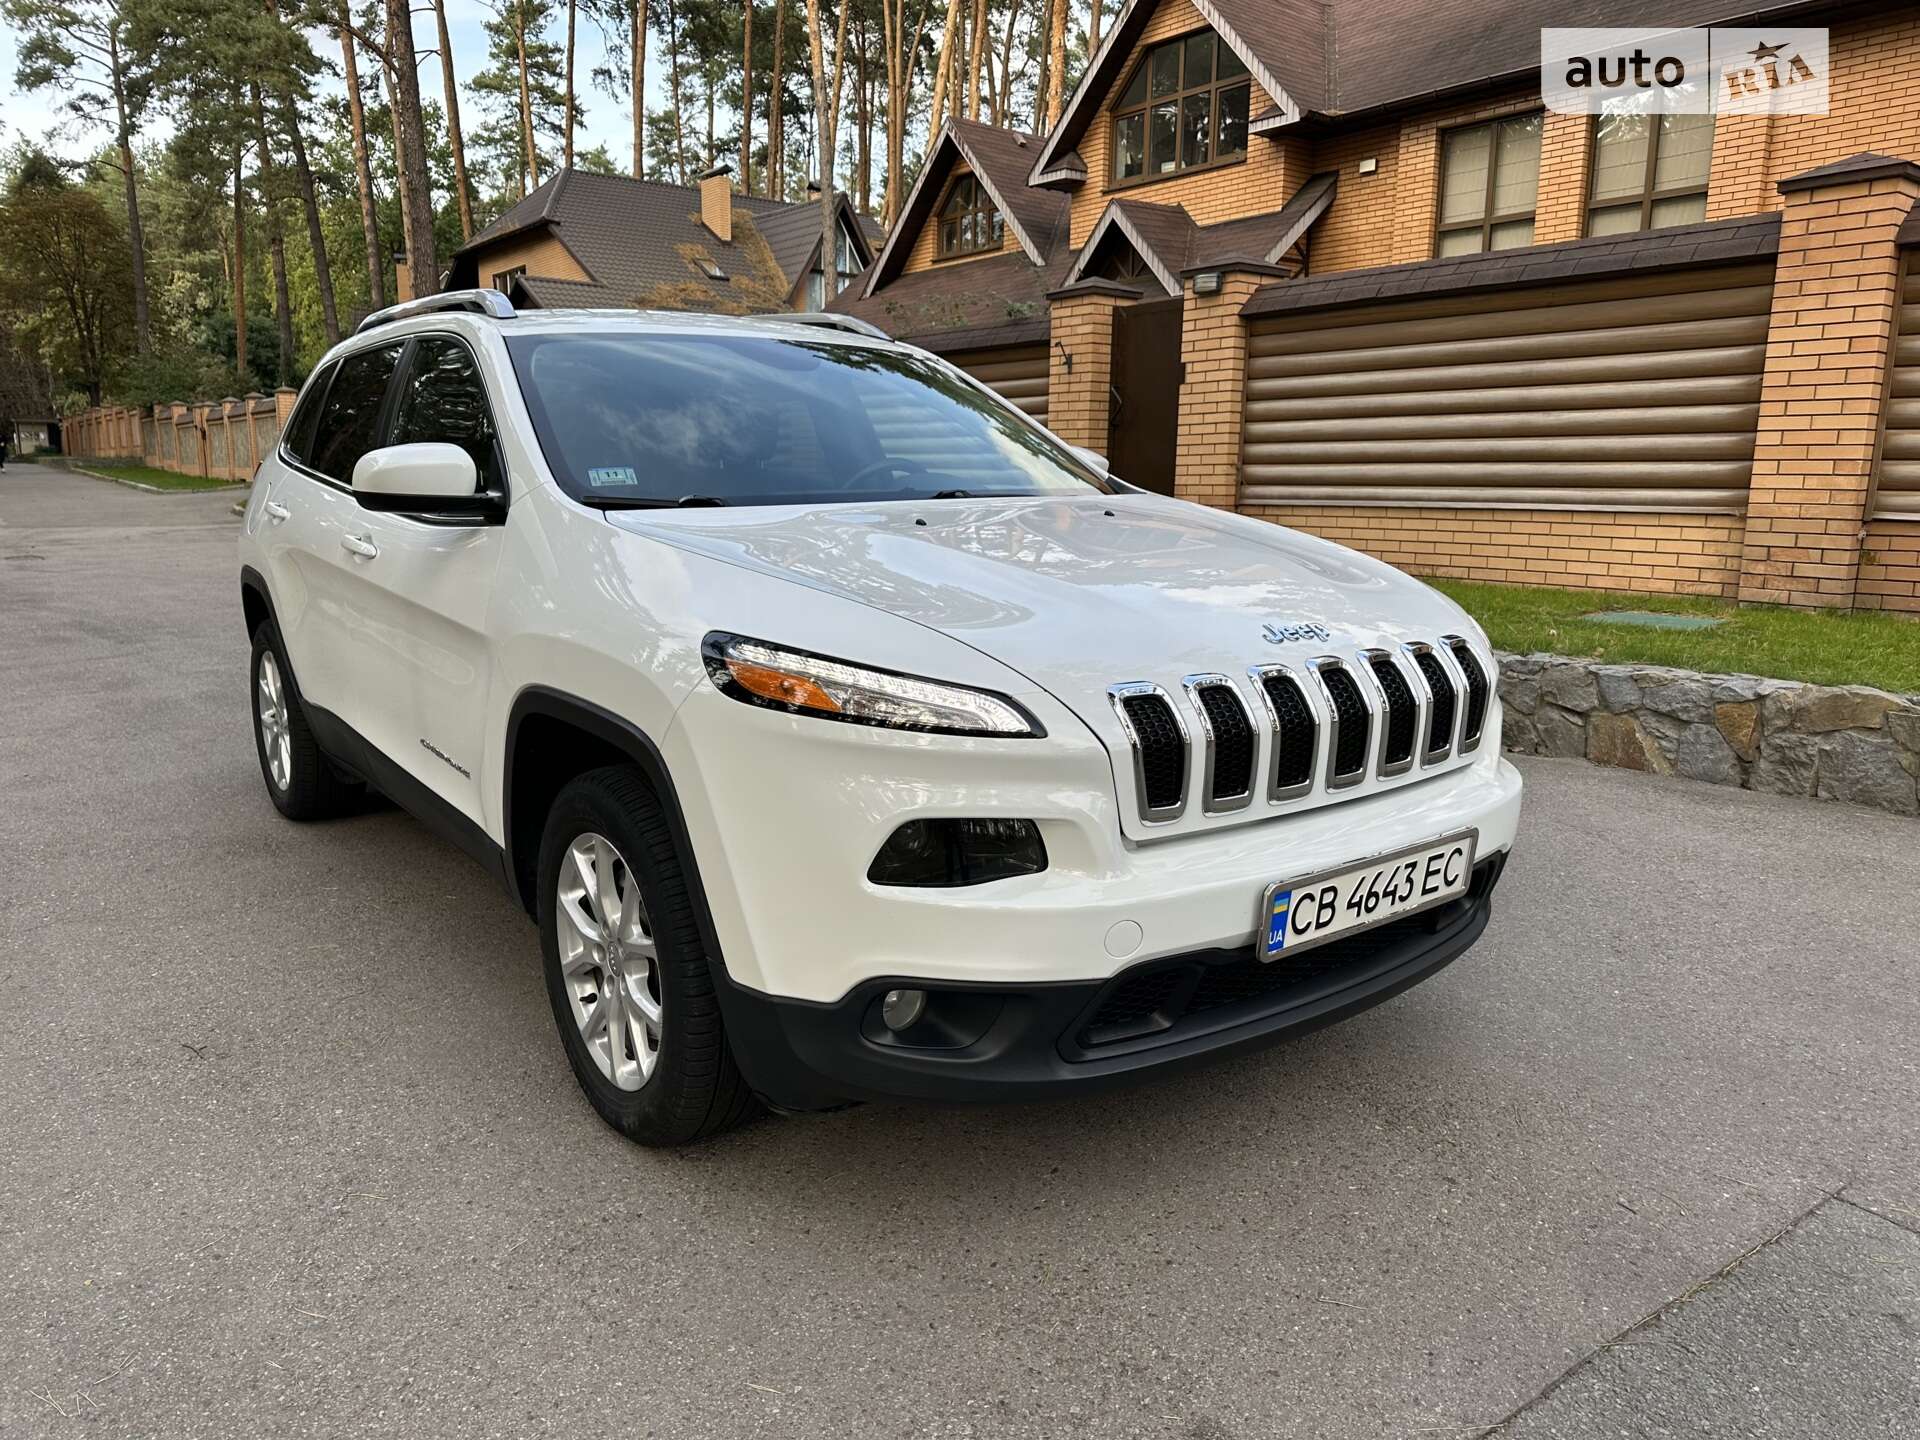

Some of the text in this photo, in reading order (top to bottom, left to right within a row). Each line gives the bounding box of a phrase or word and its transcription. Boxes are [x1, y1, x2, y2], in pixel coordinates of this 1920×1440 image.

[1262, 622, 1330, 644] Jeep
[1290, 847, 1464, 936] CB 4643 EC
[1268, 929, 1284, 945] UA
